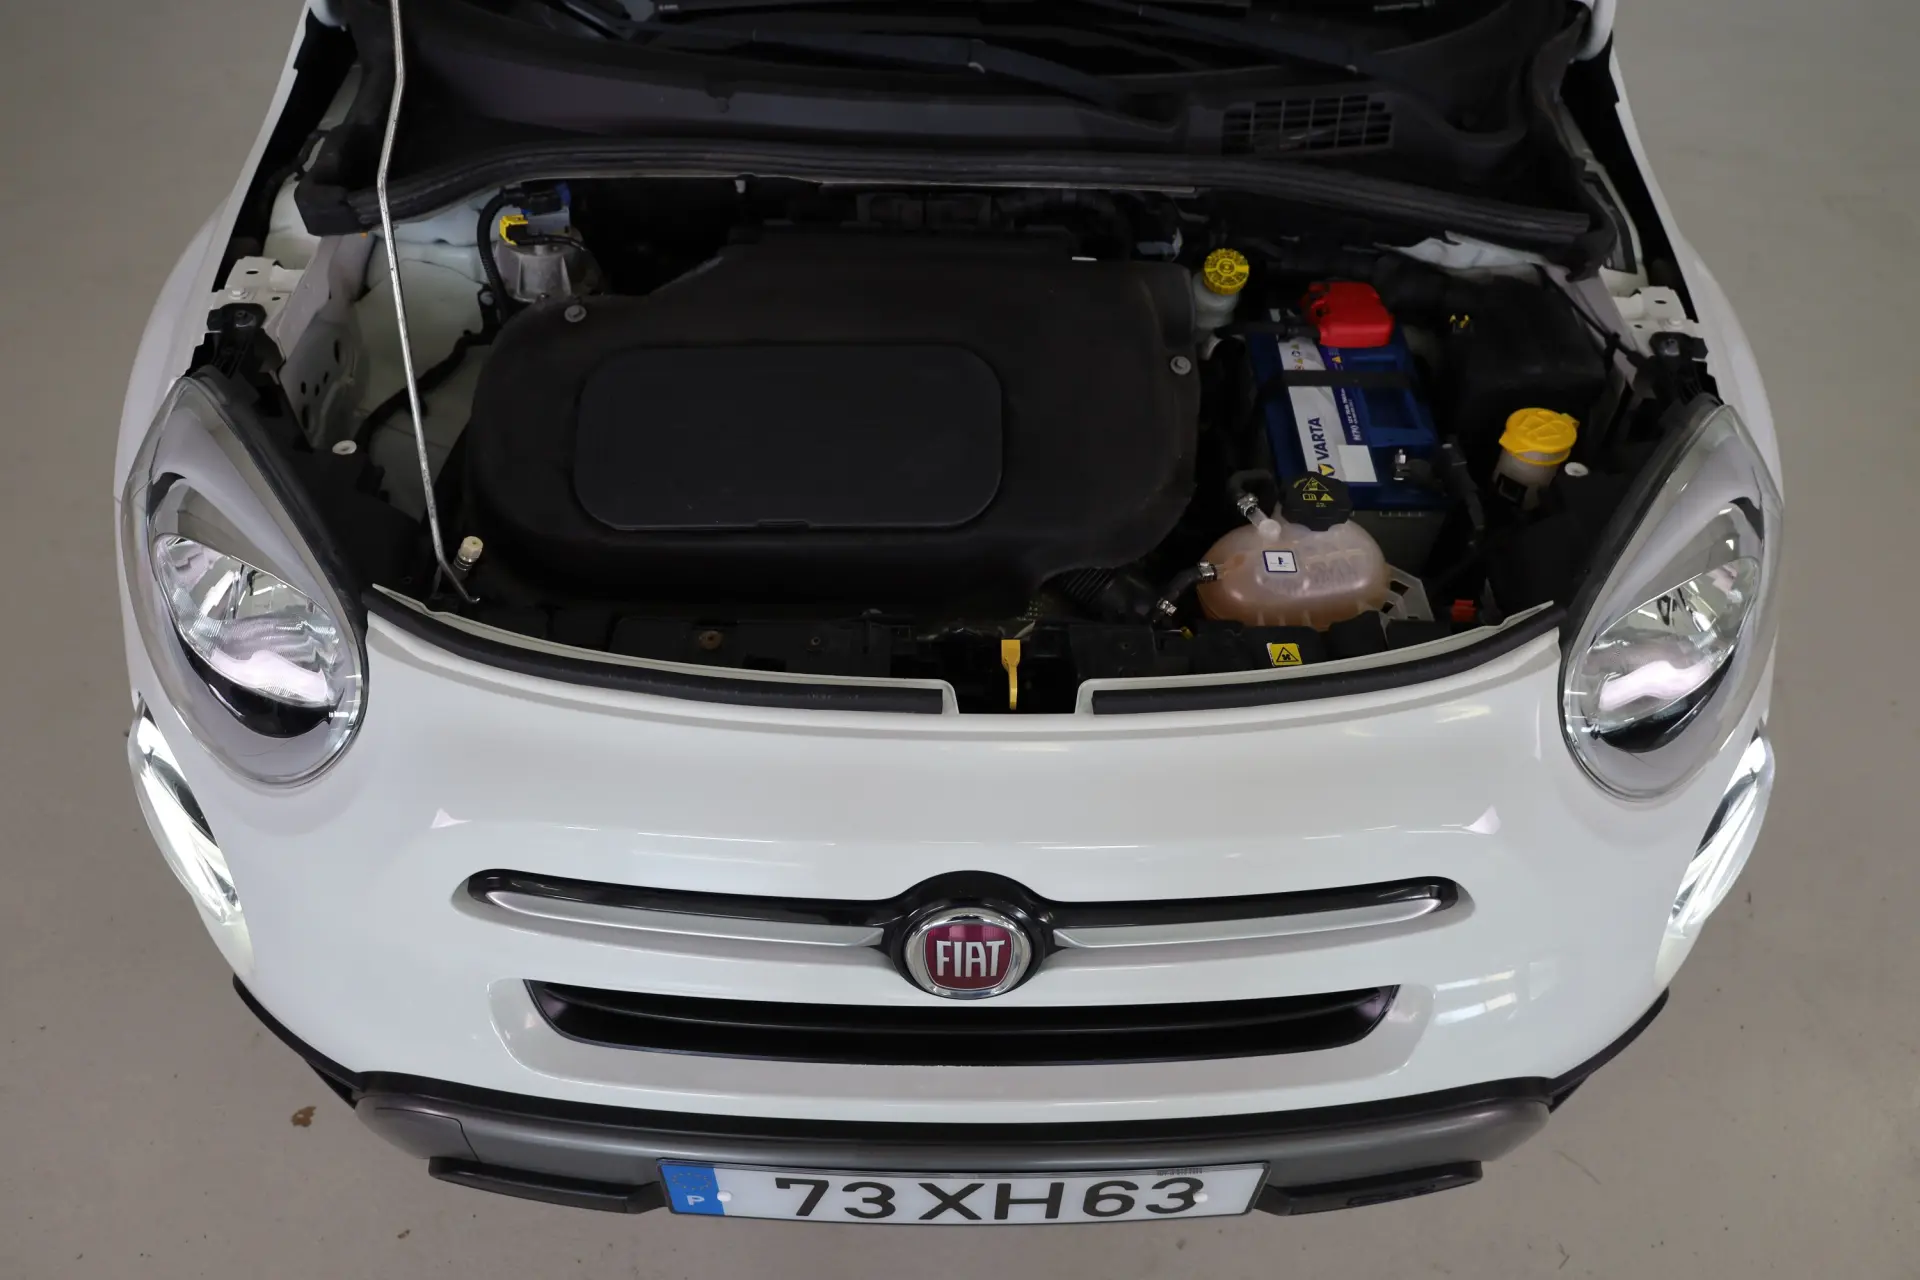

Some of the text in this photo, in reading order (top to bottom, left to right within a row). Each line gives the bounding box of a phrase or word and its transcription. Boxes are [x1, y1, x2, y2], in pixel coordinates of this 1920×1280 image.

[1308, 417, 1329, 460] VARTA
[936, 940, 1005, 977] FIAT
[687, 1195, 704, 1206] P
